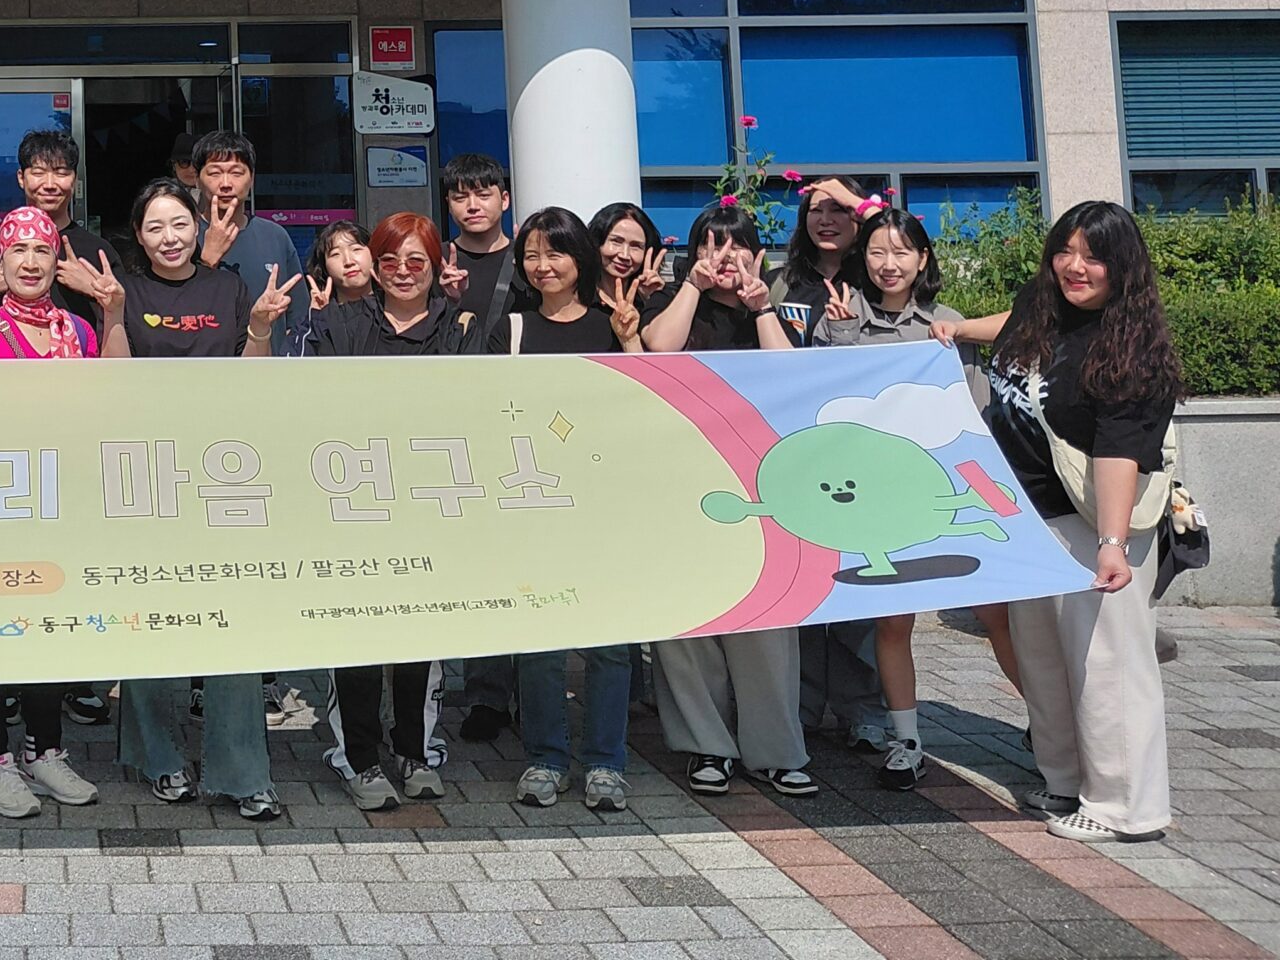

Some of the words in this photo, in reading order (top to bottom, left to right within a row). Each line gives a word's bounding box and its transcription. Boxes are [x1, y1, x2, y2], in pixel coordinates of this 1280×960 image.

[378, 40, 407, 53] 에스원
[100, 439, 273, 527] 마음
[310, 435, 576, 522] 연구소
[1, 569, 44, 588] 장소
[81, 560, 288, 586] 동구청소년문화의집
[311, 556, 382, 578] 팔공산
[387, 554, 434, 575] 일대
[38, 615, 83, 633] 동구
[85, 612, 140, 633] 청소년
[144, 612, 202, 631] 문화의
[207, 609, 229, 629] 집
